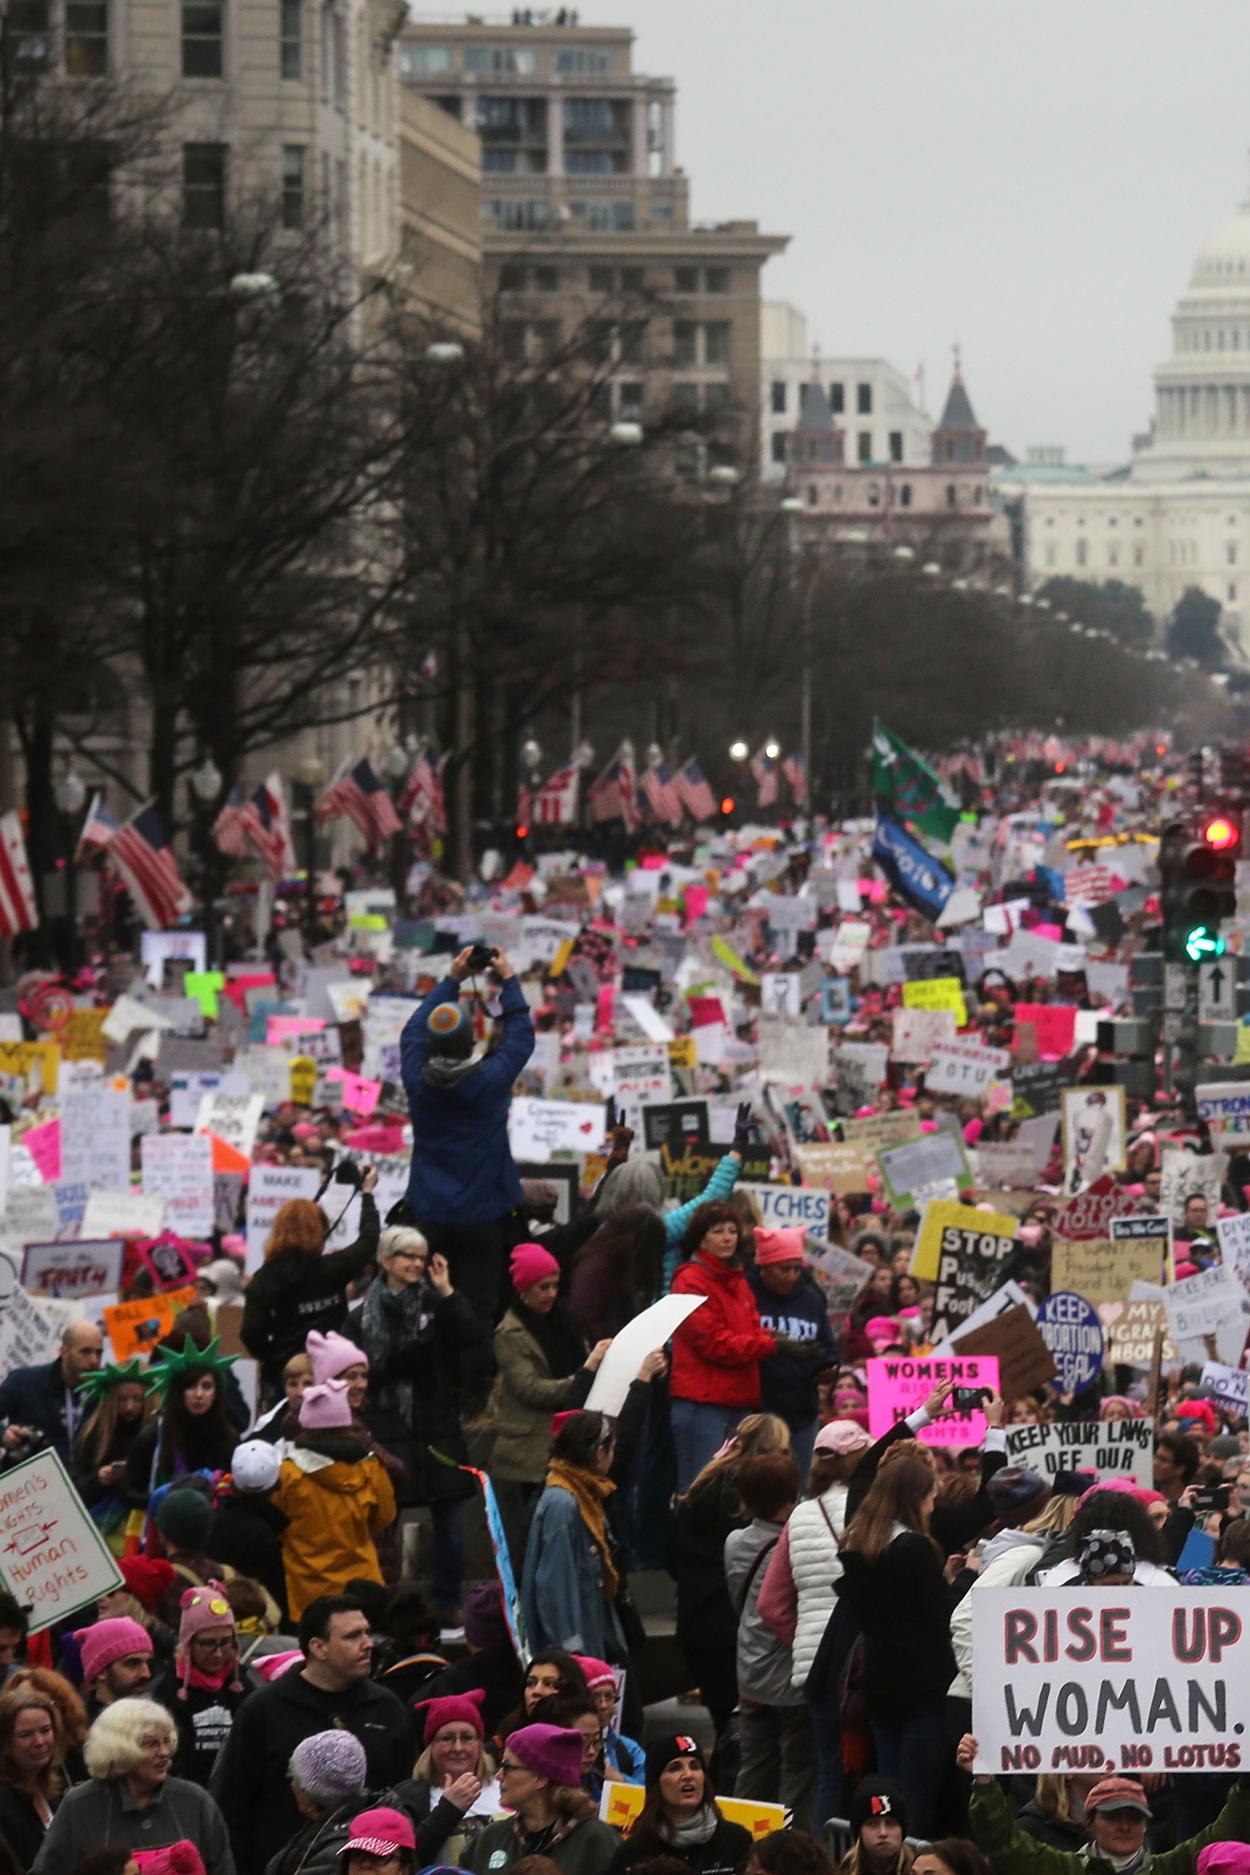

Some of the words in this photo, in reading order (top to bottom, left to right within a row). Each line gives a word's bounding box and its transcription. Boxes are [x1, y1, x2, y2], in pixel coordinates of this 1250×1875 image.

[263, 1173, 303, 1188] MAKE
[943, 1229, 1014, 1259] STOP
[1046, 1296, 1090, 1321] KEEP
[1128, 1304, 1160, 1321] MY
[885, 1362, 979, 1380] WOMENS
[1053, 1354, 1095, 1382] EGAL
[1204, 1376, 1229, 1392] DO
[1006, 1424, 1051, 1455] KEEP
[1053, 1423, 1100, 1447] YOUR
[1045, 1452, 1082, 1475] OFF
[1096, 1450, 1134, 1471] OUR
[8, 1537, 78, 1583] Human
[25, 1564, 89, 1604] Rights
[1004, 1607, 1133, 1664] RISE
[1172, 1607, 1242, 1664] UP
[1004, 1677, 1245, 1737] WOMAN.
[1001, 1744, 1042, 1771] NO
[1051, 1744, 1116, 1773] MUD,
[1120, 1743, 1153, 1769] NO
[1163, 1743, 1242, 1769] LOTUS
